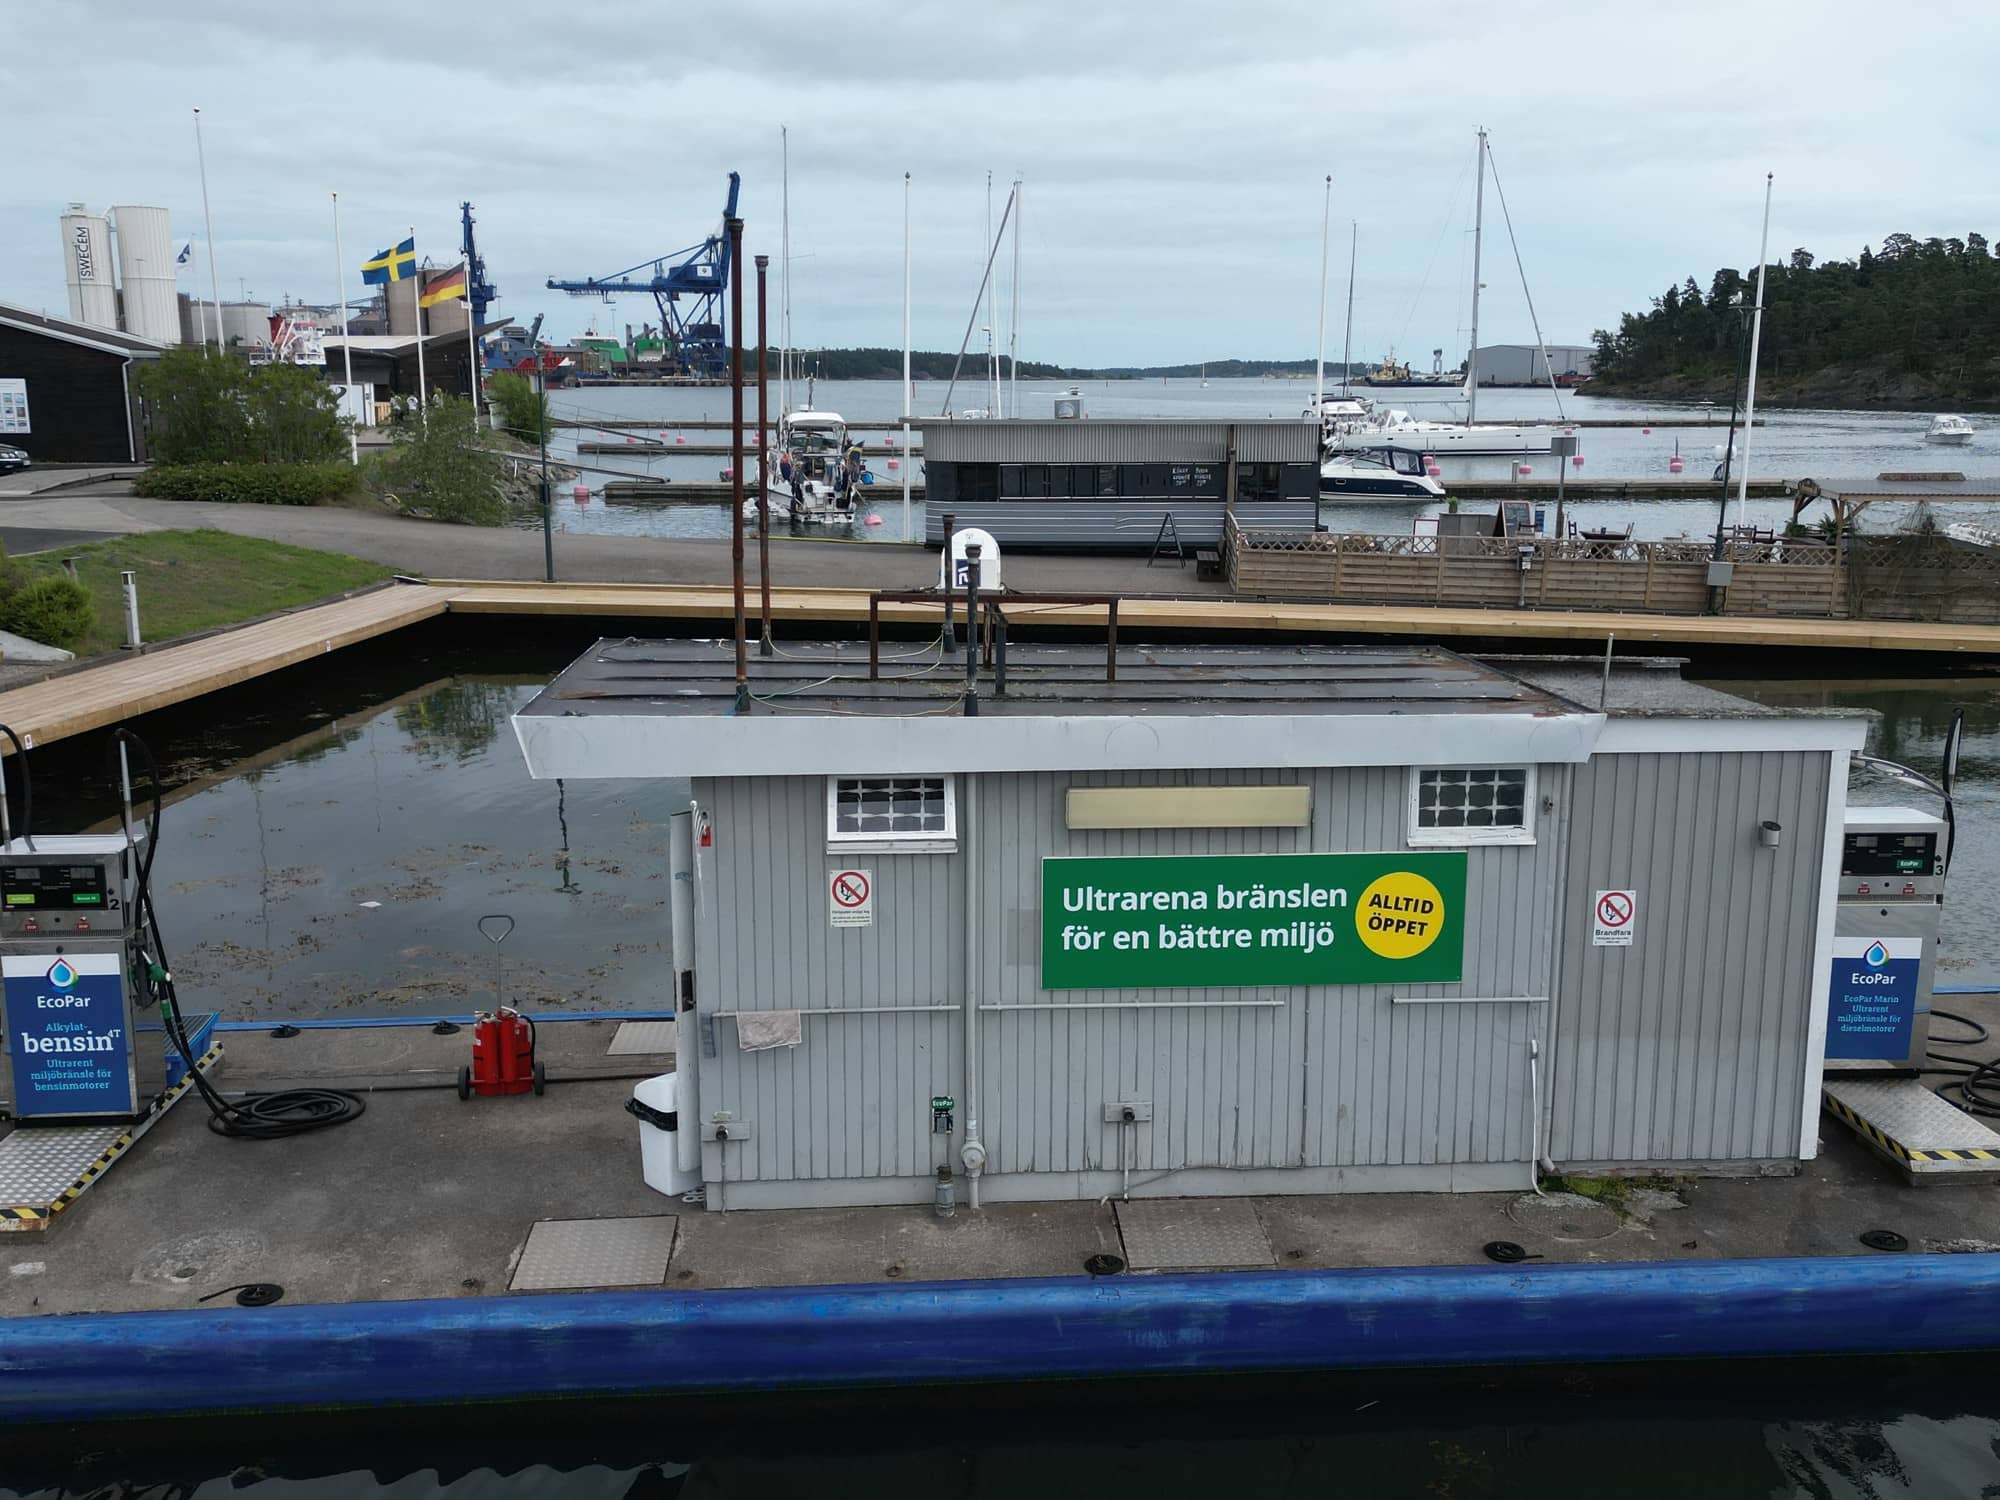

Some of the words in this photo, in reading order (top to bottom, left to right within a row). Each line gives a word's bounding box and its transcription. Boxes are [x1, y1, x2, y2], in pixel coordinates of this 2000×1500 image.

[76, 227, 91, 277] SWECEM
[1935, 865, 1944, 876] 3
[1062, 886, 1207, 912] Ultrarena
[1217, 883, 1348, 910] bränslen
[109, 899, 120, 910] 2
[1368, 893, 1434, 914] ALLTID
[1368, 912, 1428, 937] ÖPPET
[1061, 924, 1106, 950] för
[1113, 930, 1150, 949] en
[1159, 924, 1251, 950] bättre
[1260, 921, 1335, 953] miljö
[1851, 973, 1897, 985] EcoPar
[37, 995, 91, 1009] EcoPar
[1843, 995, 1873, 1003] EcoPar
[1874, 995, 1899, 1003] Marin
[1852, 1005, 1889, 1013] Ultrarent
[1837, 1014, 1888, 1023] miljöbränsle
[1889, 1015, 1902, 1023] för
[45, 1023, 88, 1033] Alkylat-
[1840, 1024, 1896, 1032] dieselmotorer
[21, 1031, 114, 1053] bensin
[46, 1059, 93, 1068] Ultrarent
[30, 1070, 95, 1081] miljöbränsle
[97, 1069, 112, 1078] för
[34, 1082, 110, 1091] bensinmotorer
